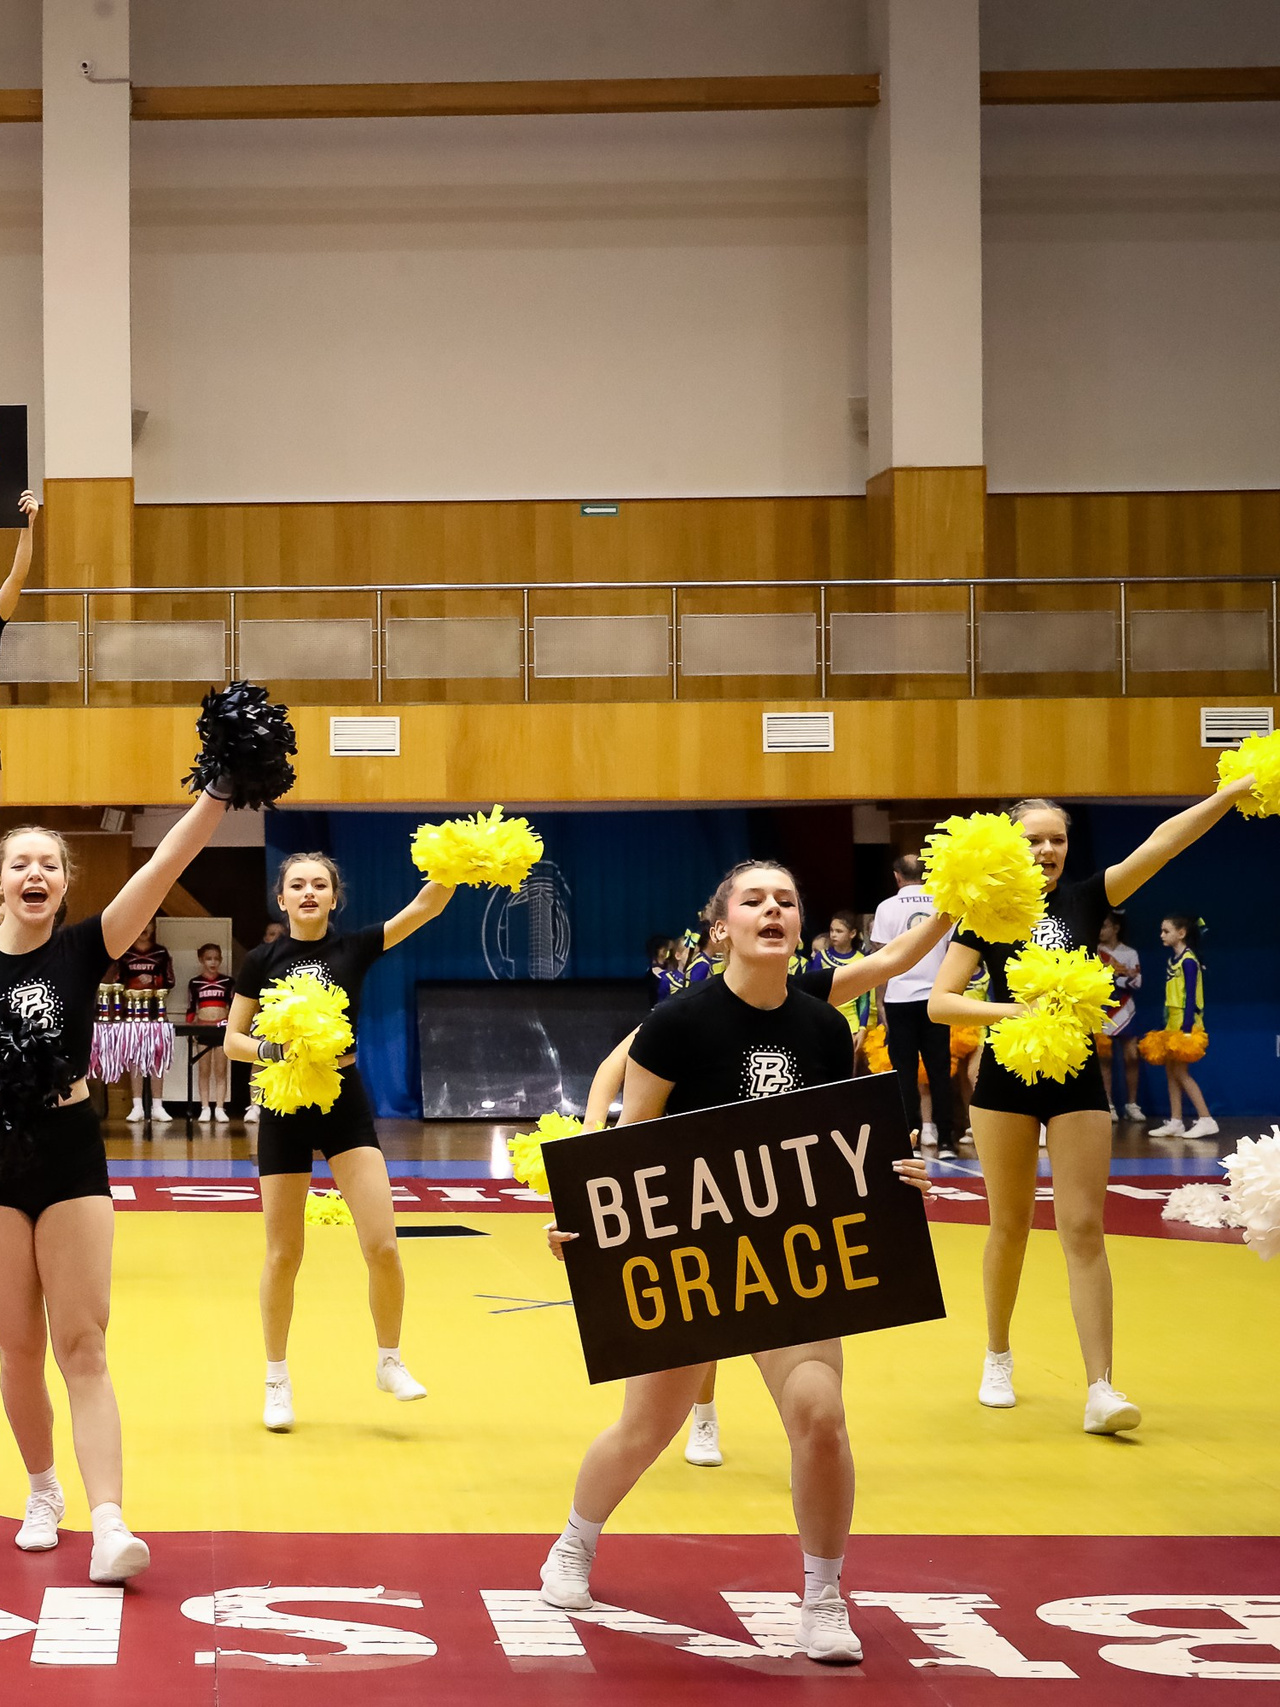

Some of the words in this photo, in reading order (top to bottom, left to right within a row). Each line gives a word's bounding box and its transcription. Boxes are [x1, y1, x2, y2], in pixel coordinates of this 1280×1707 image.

[898, 896, 933, 904] ТРЕНЕ
[586, 1122, 872, 1249] BEAUTY
[621, 1211, 880, 1331] GRACE
